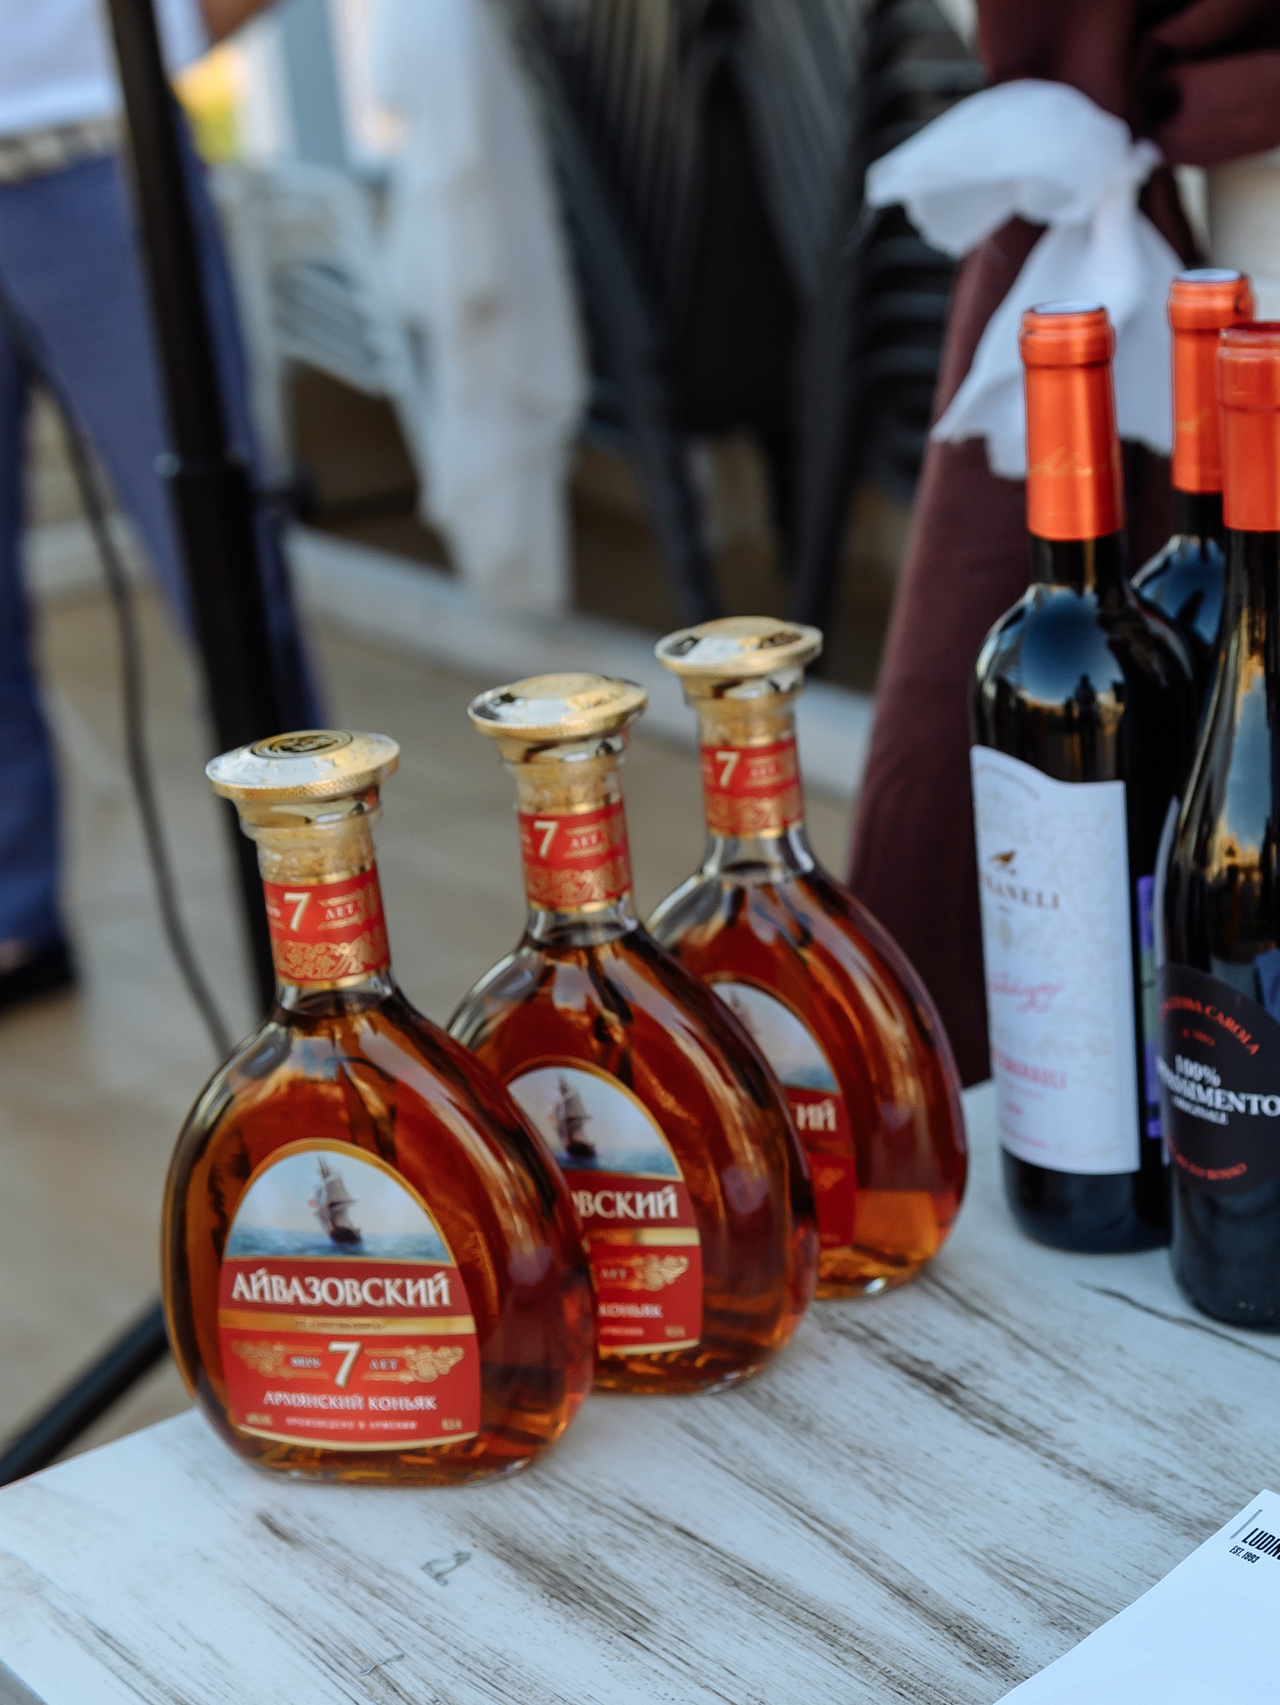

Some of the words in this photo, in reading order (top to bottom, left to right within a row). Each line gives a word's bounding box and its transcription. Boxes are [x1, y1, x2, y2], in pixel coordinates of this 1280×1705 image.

[715, 750, 739, 787] 7
[533, 820, 558, 859] 7
[284, 892, 310, 933] 7
[325, 903, 356, 920] ЛЕТ
[231, 1267, 452, 1308] АЙВАЗОВСКИЙ
[327, 1340, 362, 1389] 7
[368, 1395, 438, 1411] КОНЬЯК
[1229, 1545, 1242, 1557] EST.
[1241, 1549, 1261, 1565] 1993
